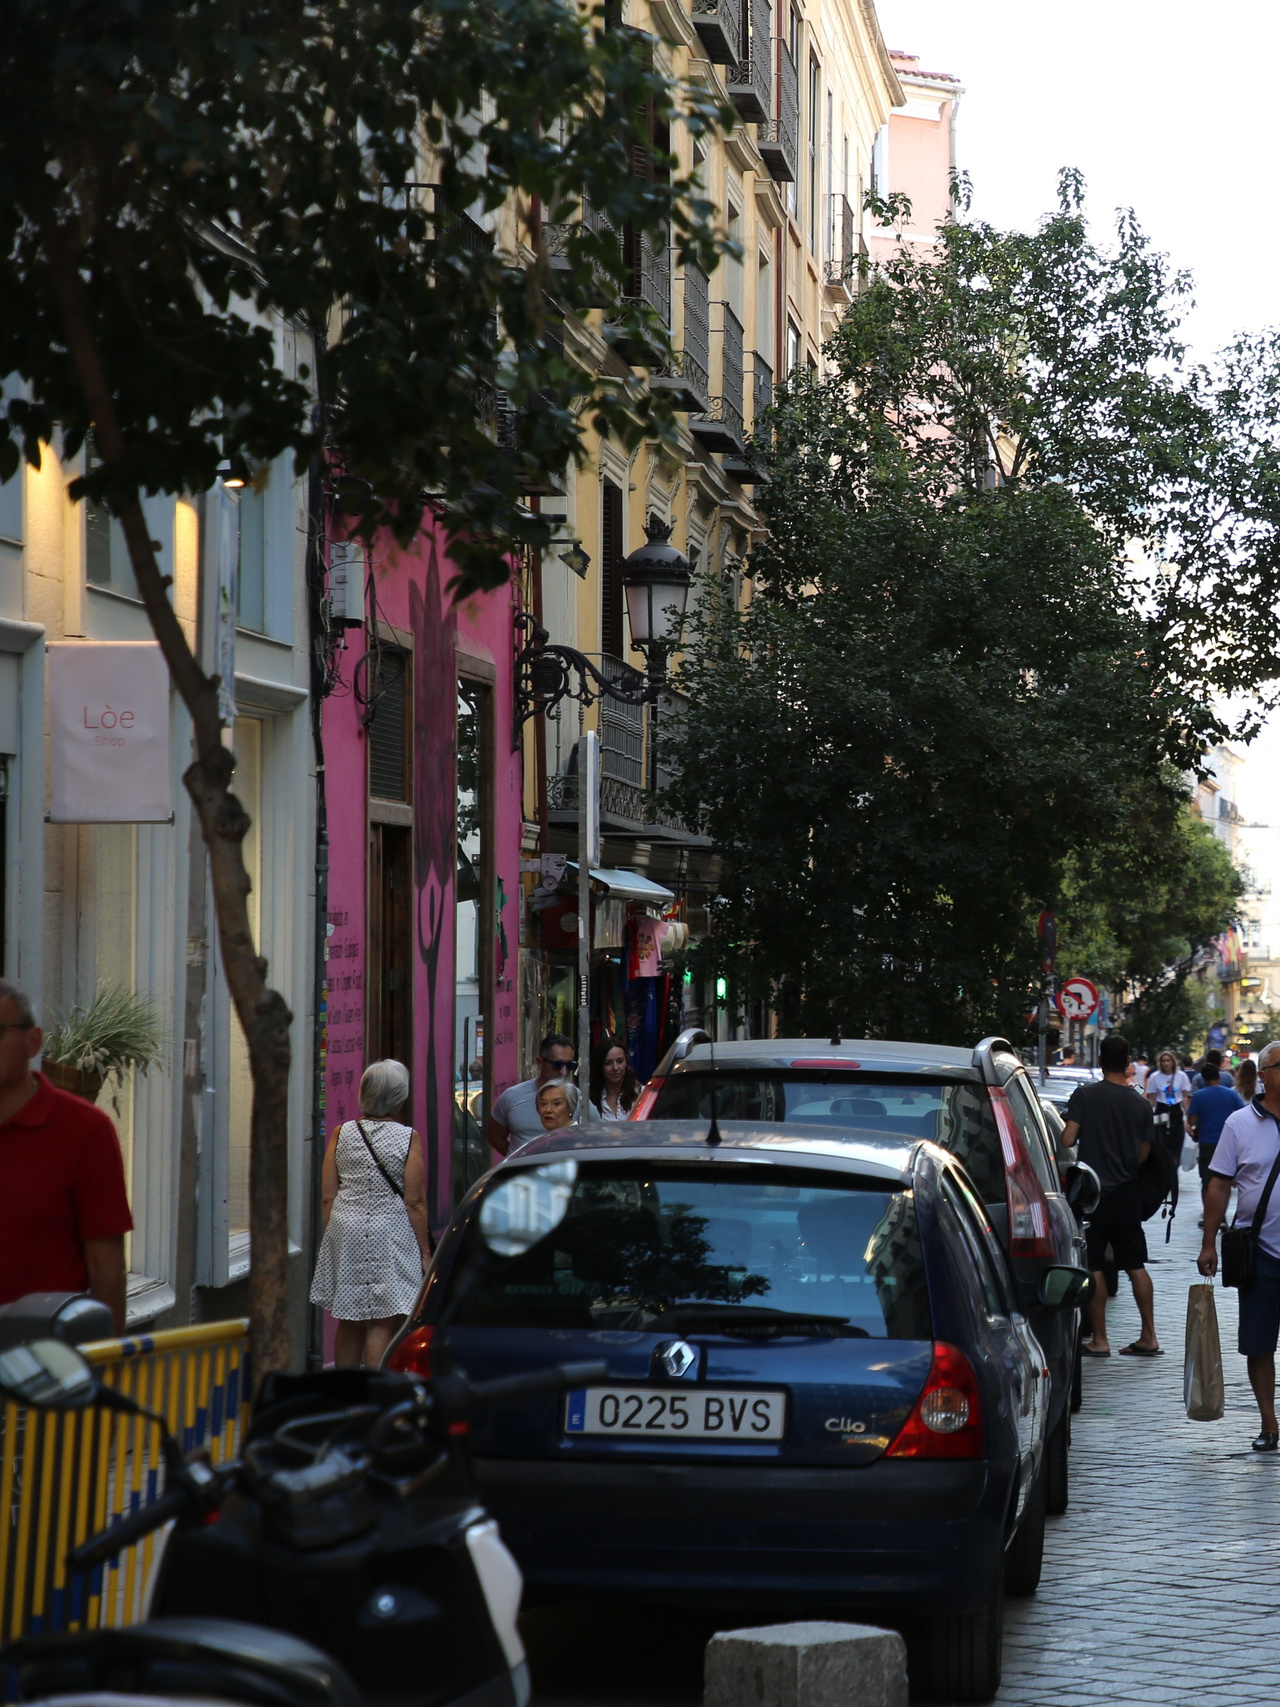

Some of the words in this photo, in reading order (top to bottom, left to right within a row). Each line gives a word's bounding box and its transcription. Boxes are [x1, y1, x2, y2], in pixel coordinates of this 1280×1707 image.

[83, 704, 135, 729] Lòe
[94, 735, 126, 747] Shop
[571, 1414, 580, 1425] E
[598, 1394, 689, 1430] 0225
[703, 1398, 772, 1433] BVS
[824, 1416, 866, 1433] Clio
